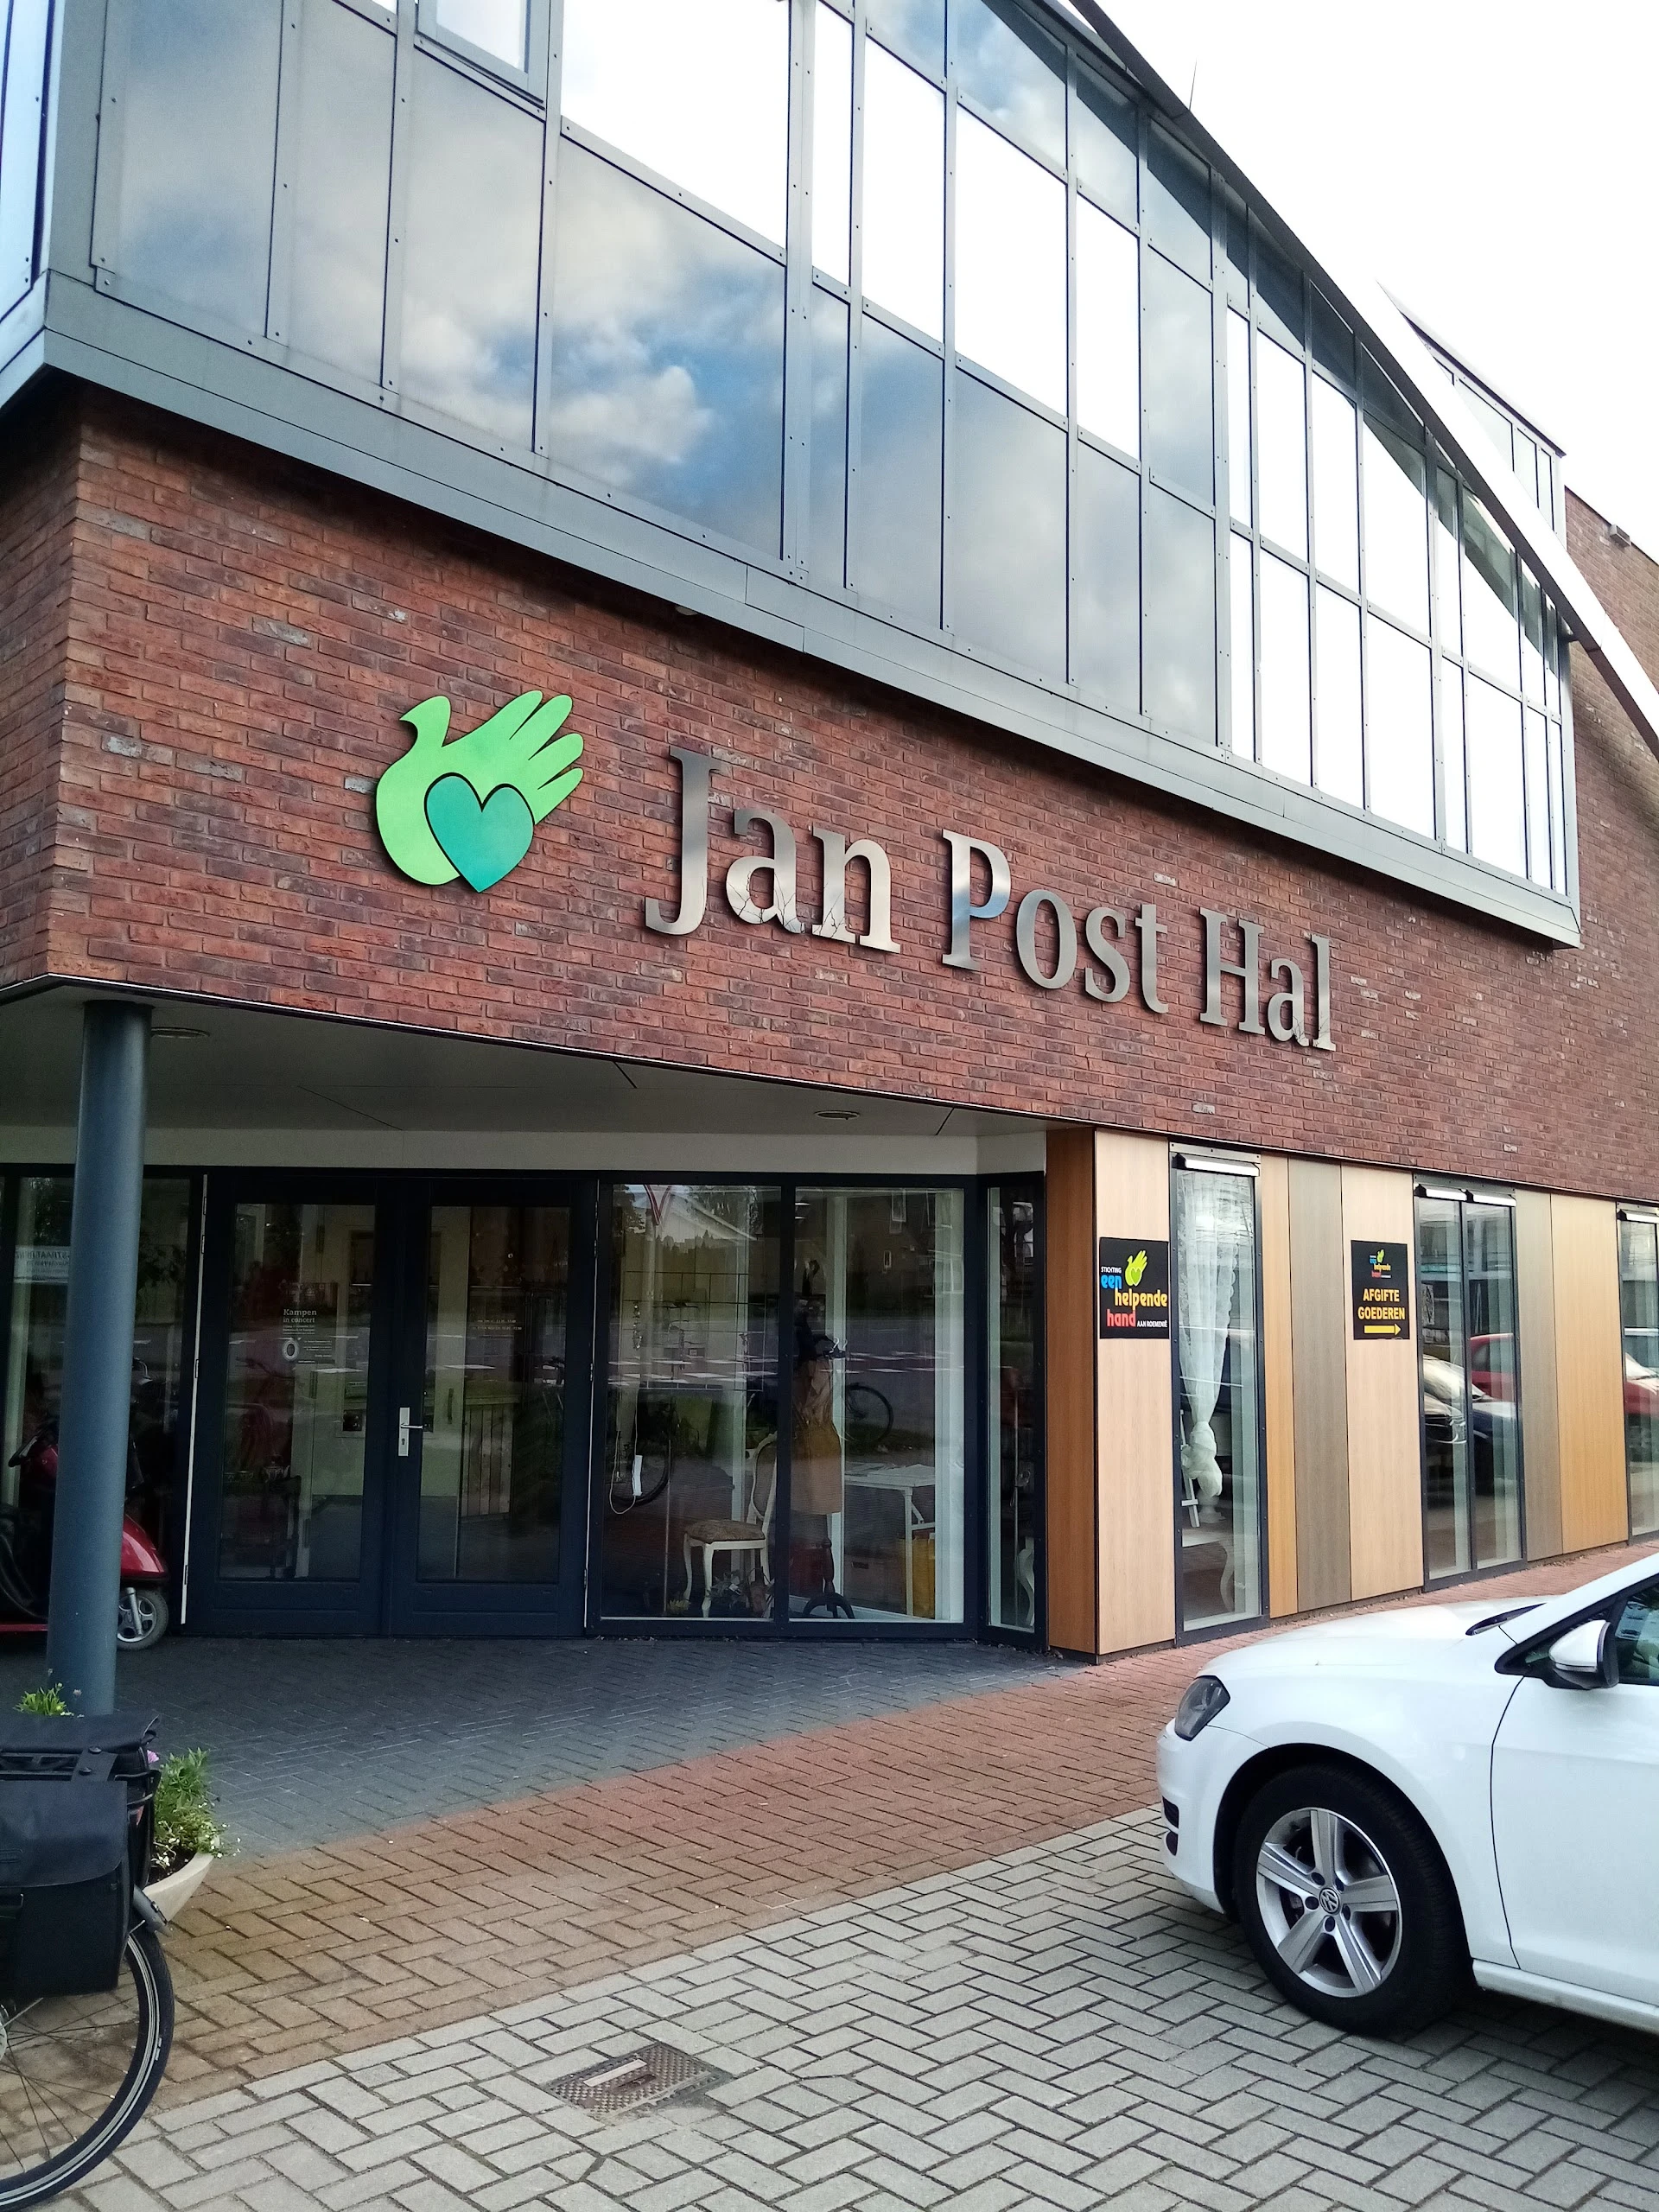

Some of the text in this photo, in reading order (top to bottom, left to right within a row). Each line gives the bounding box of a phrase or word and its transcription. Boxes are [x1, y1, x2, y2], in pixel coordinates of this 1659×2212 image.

[645, 746, 1337, 1052] Jan Post Hal
[1101, 1274, 1122, 1289] een
[1115, 1288, 1167, 1311] helpende
[1363, 1288, 1400, 1302] AFGIFTE
[283, 1308, 317, 1317] Kampen
[1107, 1308, 1136, 1327] hand
[1357, 1306, 1406, 1320] GOEDEREN
